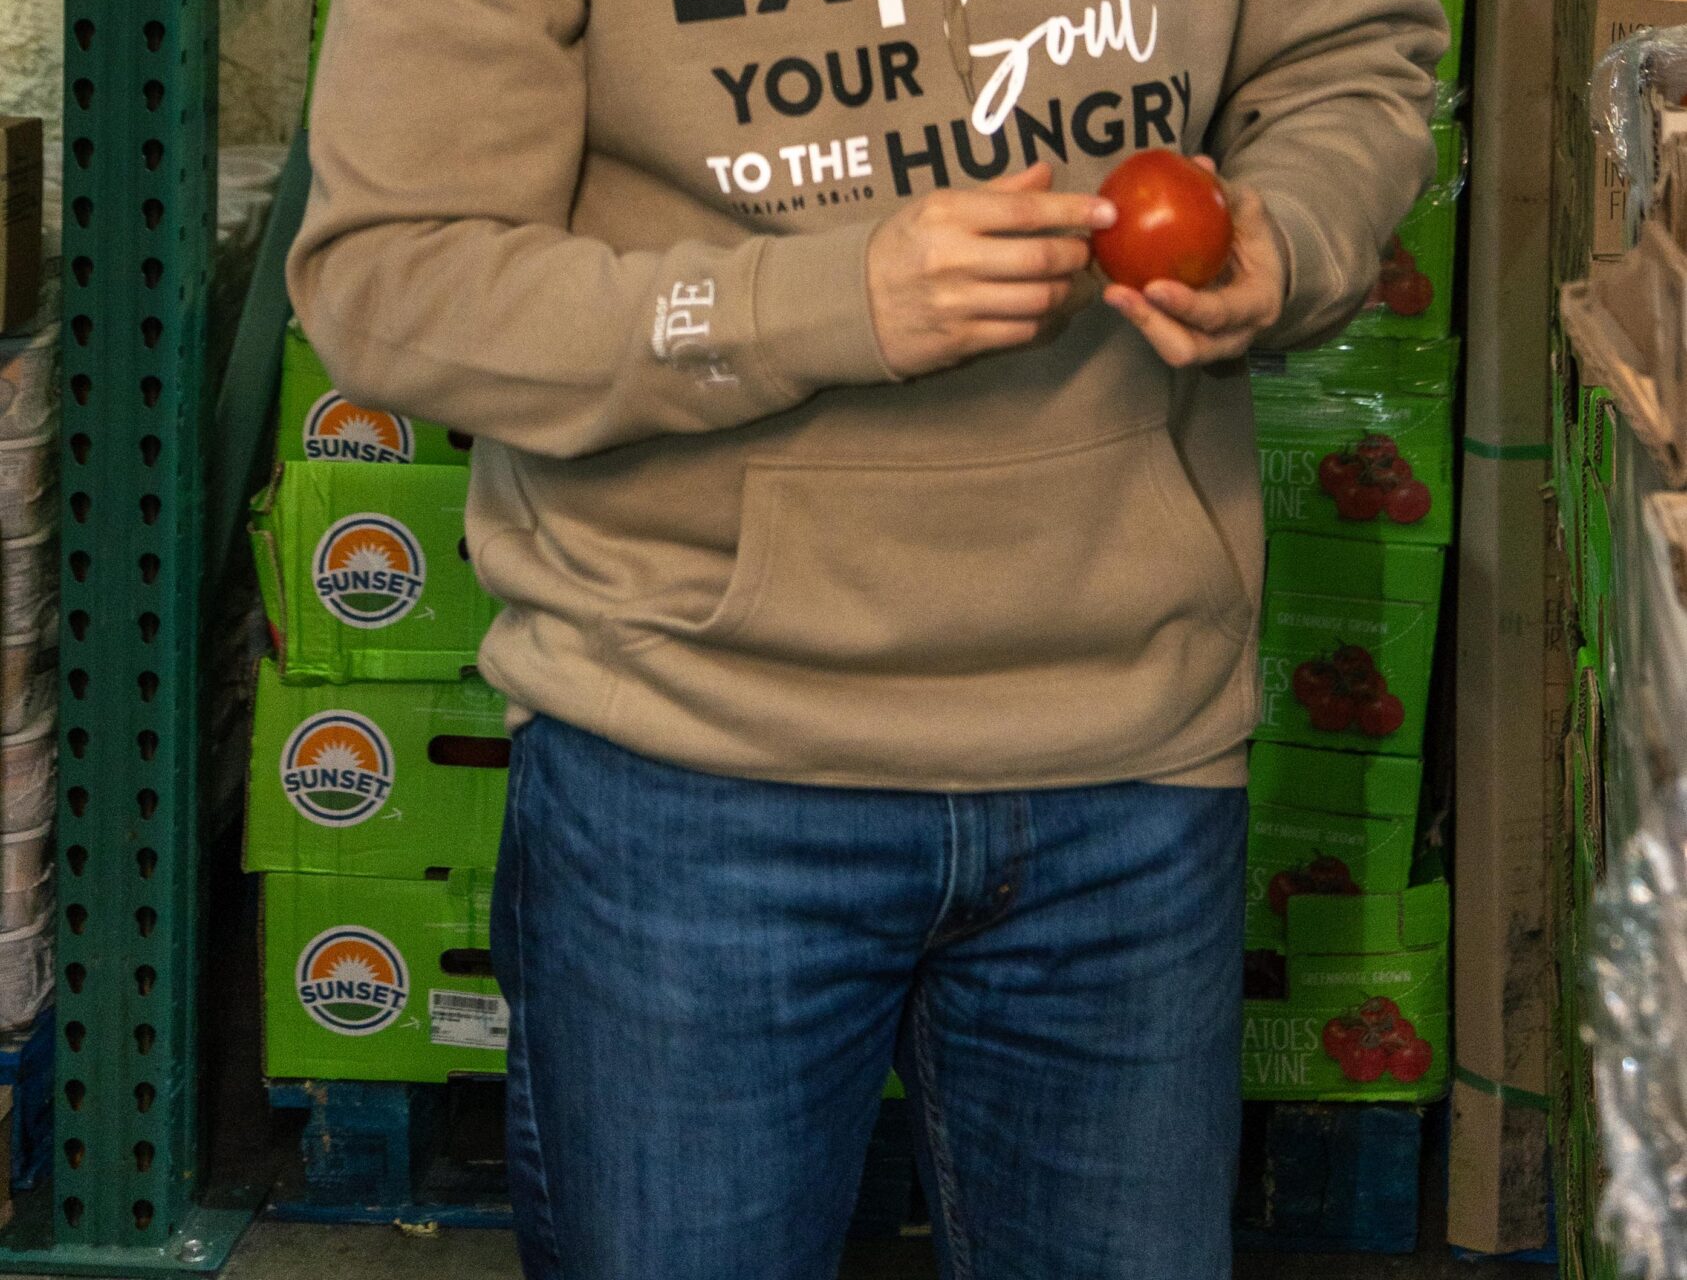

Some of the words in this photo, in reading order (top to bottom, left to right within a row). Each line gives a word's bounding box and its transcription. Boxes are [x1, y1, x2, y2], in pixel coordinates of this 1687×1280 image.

[712, 41, 924, 124] YOUR
[885, 71, 1190, 197] HUNGRY
[706, 151, 772, 194] TO
[779, 136, 874, 187] THE
[316, 570, 422, 598] SUNSET
[284, 768, 391, 799] SUNSET
[301, 976, 406, 1010] SUNSET
[1254, 1052, 1313, 1084] VINE
